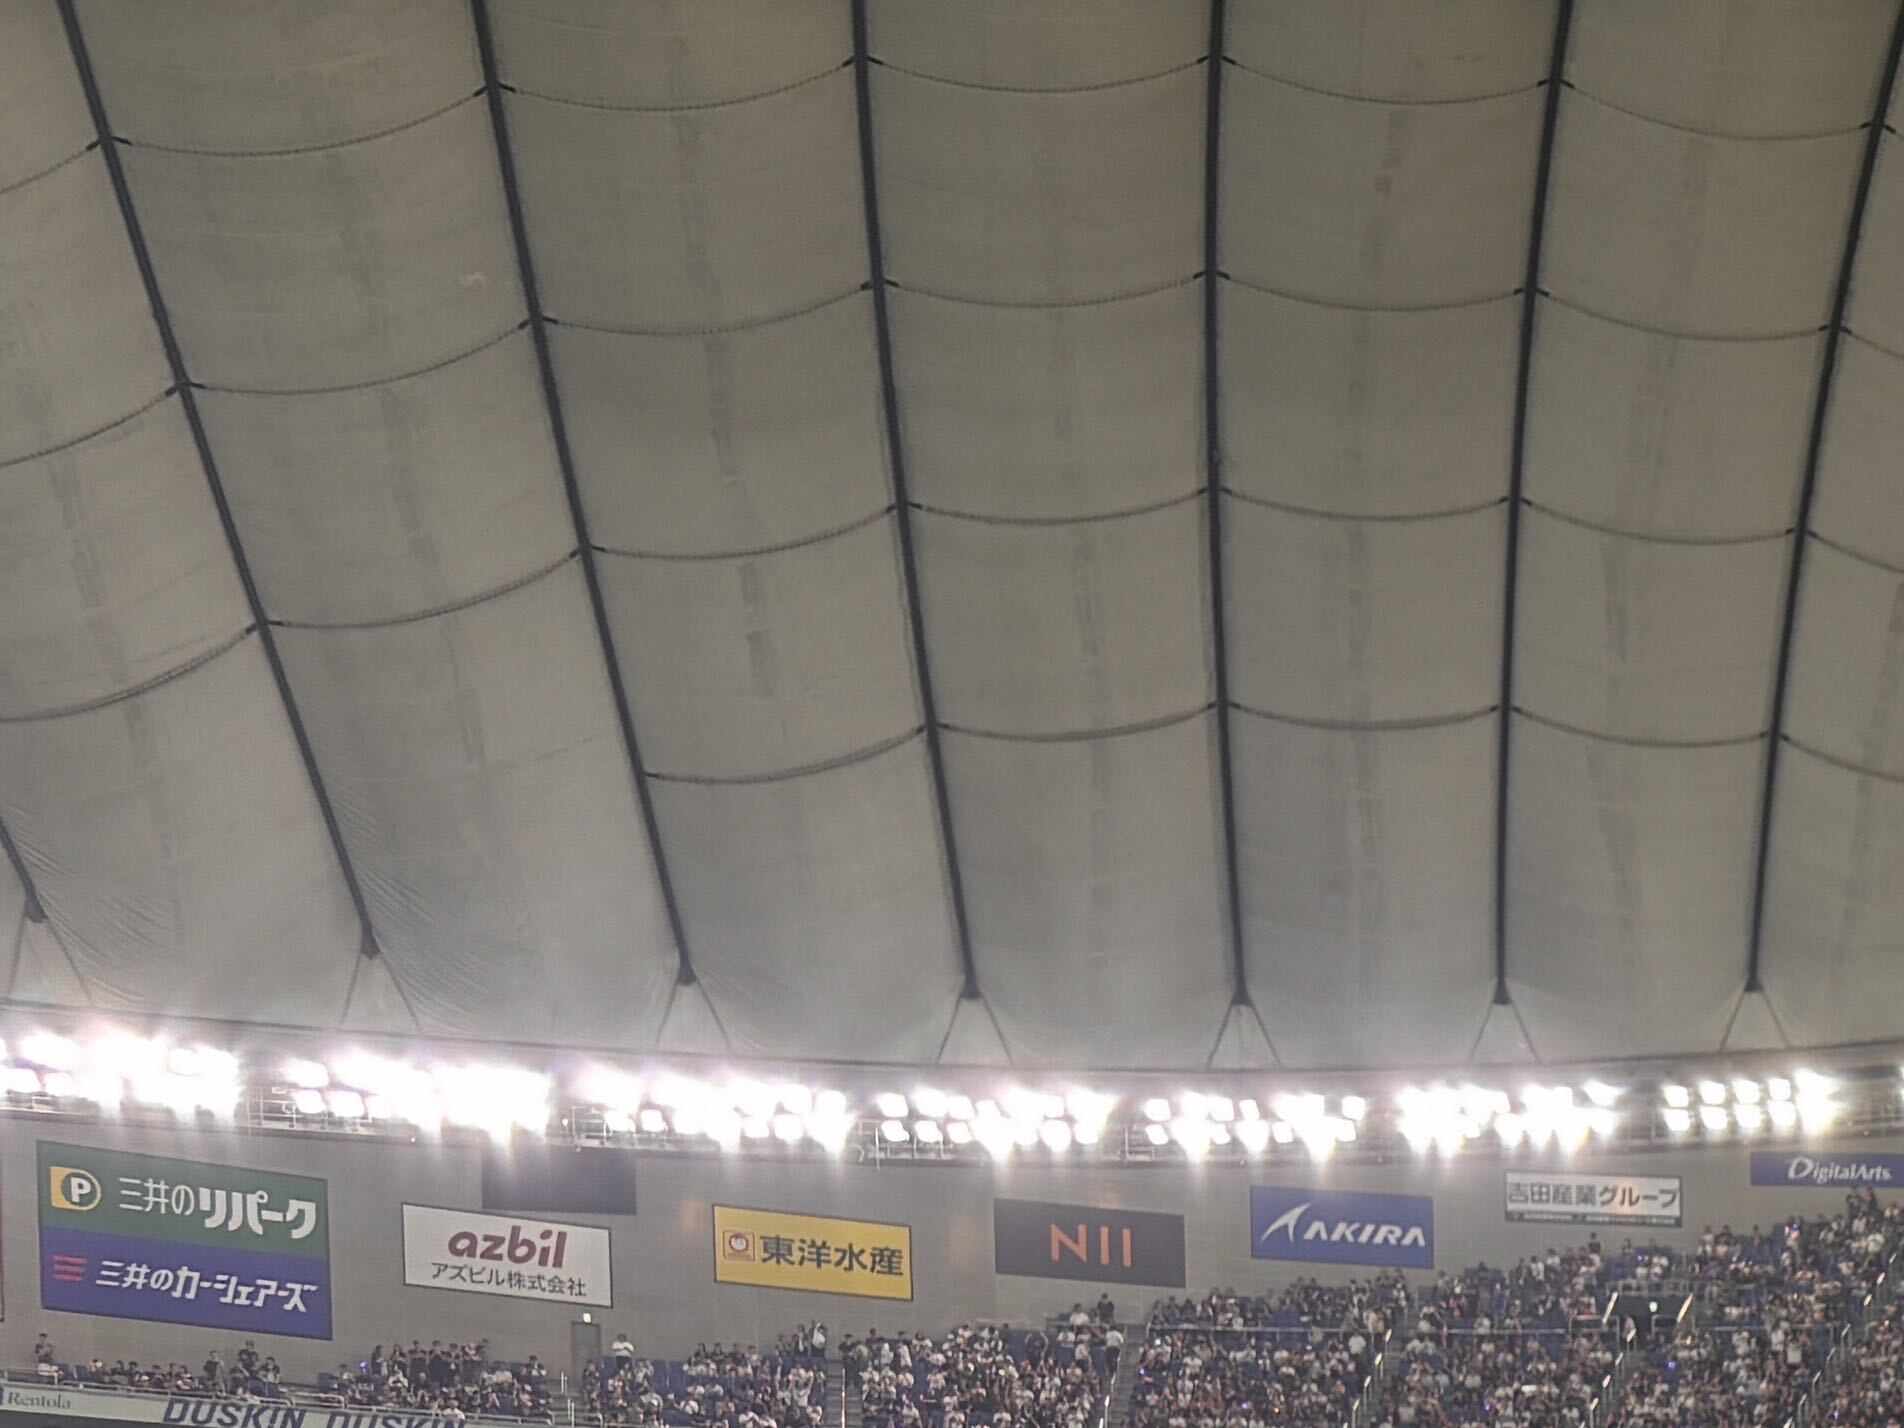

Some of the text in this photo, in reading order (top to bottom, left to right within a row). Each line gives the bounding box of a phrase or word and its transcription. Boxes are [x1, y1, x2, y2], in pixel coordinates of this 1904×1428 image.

[69, 1177, 92, 1203] P
[1788, 1156, 1891, 1184] DigitalArts
[118, 1177, 317, 1239] 三井のリパーク
[448, 1225, 567, 1270] azbil
[1303, 1216, 1426, 1248] AKIRA
[761, 1234, 905, 1278] 東洋水産
[95, 1260, 319, 1313] 三井のカーシェアーズ
[430, 1262, 587, 1299] アズビル株式会社
